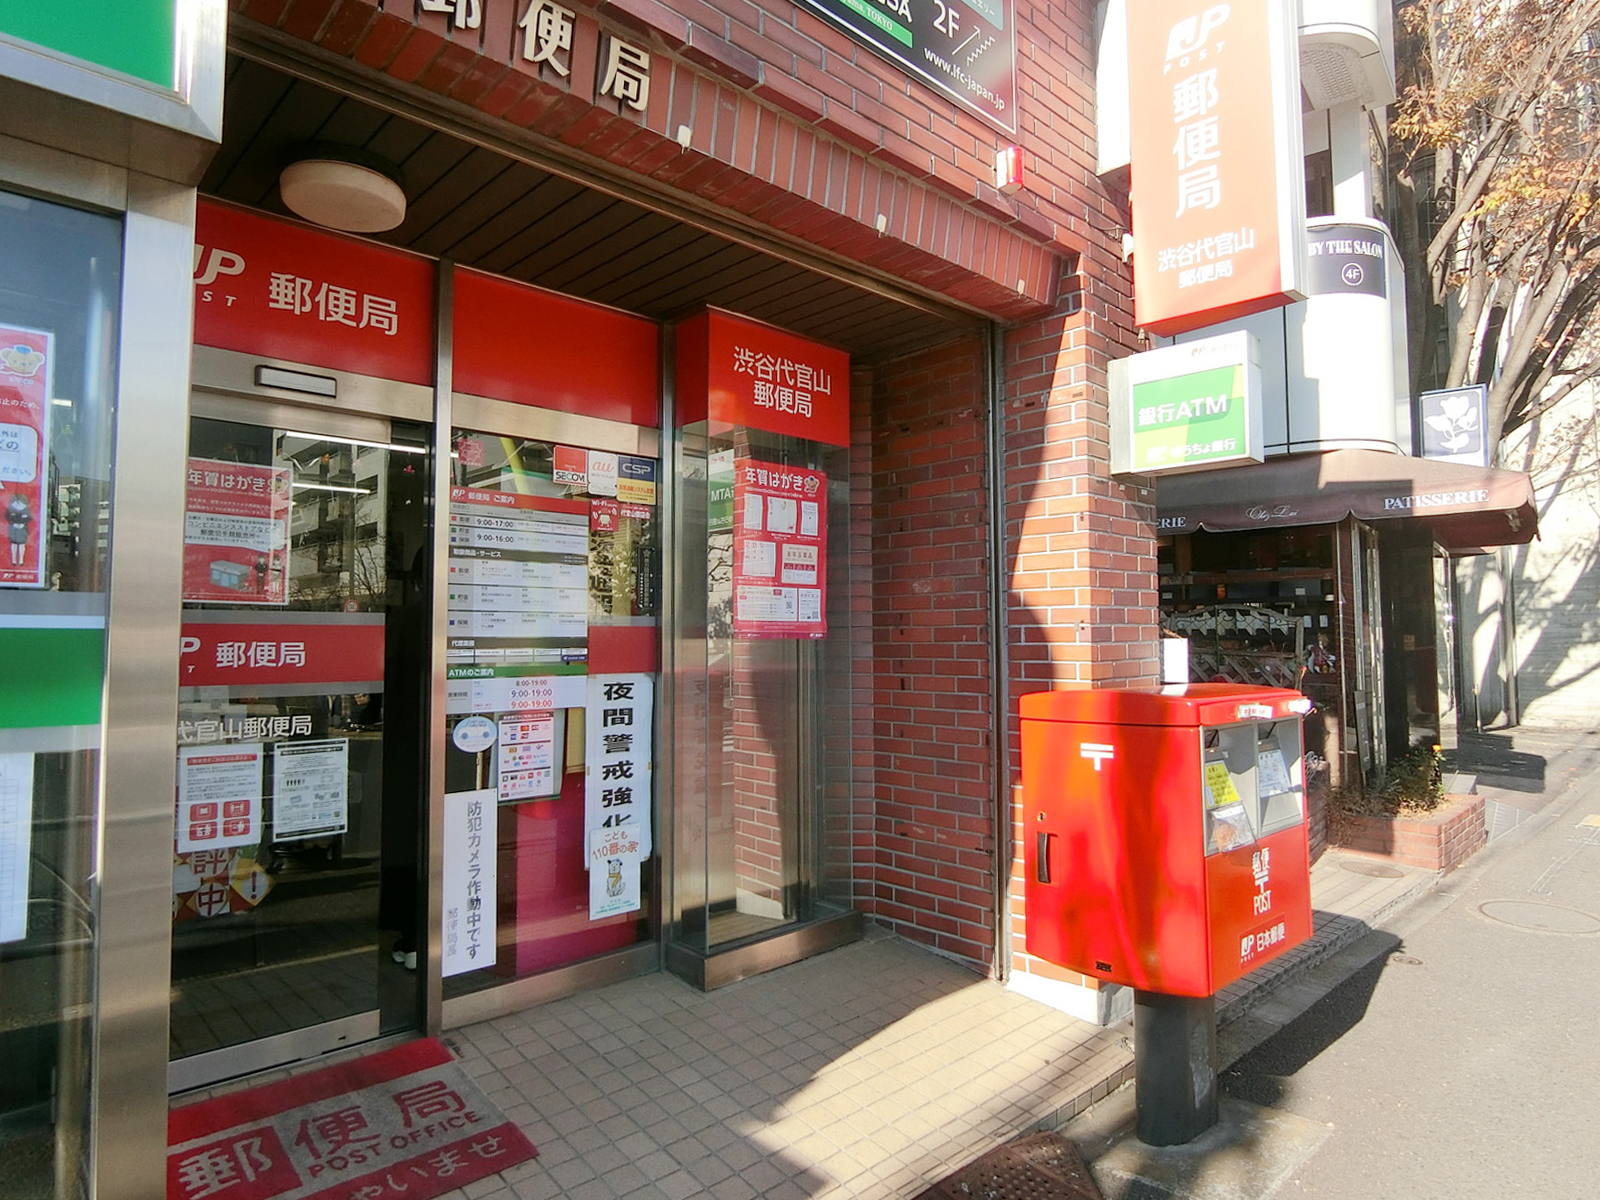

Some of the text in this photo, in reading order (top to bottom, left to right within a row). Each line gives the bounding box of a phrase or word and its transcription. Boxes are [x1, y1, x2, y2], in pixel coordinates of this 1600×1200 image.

[866, 7, 893, 31] TOKYO
[932, 0, 960, 38] 2F
[1162, 41, 1226, 75] POST
[923, 47, 1006, 111] www.lfc-japan.jp
[1172, 67, 1221, 219] 郵便局
[1158, 227, 1254, 272] 渋谷代官山
[1307, 240, 1383, 259] BY THE SALON
[1178, 259, 1233, 289] 郵便局
[1345, 268, 1360, 279] 4F
[269, 272, 398, 336] 郵便局
[733, 345, 831, 396] 渋谷代官山
[0, 397, 40, 410] 止のため、
[753, 380, 812, 418] 郵便局
[1137, 394, 1227, 427] 銀行ATM
[188, 468, 266, 492] 年賀はがき
[555, 470, 585, 482] SECOM
[592, 461, 615, 473] au
[622, 462, 651, 475] CSP
[745, 466, 803, 492] 年賀はがき
[467, 492, 490, 502] 郵便局
[1383, 488, 1490, 511] PATISSERIE
[476, 519, 514, 528] 9:00-17:00
[477, 534, 514, 543] 9:00-16:00
[215, 641, 306, 668] 郵便局
[511, 688, 552, 698] 9:00-19:00
[516, 679, 547, 687] 8:00-19:00
[511, 699, 552, 709] 9:00-19:00
[602, 682, 635, 828] 夜間警戒強化
[604, 830, 628, 843] こども
[592, 840, 639, 861] 110番の家
[1252, 847, 1270, 875] 郵便
[466, 800, 483, 960] 防犯カメラ作動中です
[197, 883, 224, 917] 中
[1253, 890, 1272, 916] POST
[1256, 922, 1285, 952] 日本郵便
[178, 1080, 465, 1199] 郵便局
[307, 1110, 482, 1179] POST OFFICE
